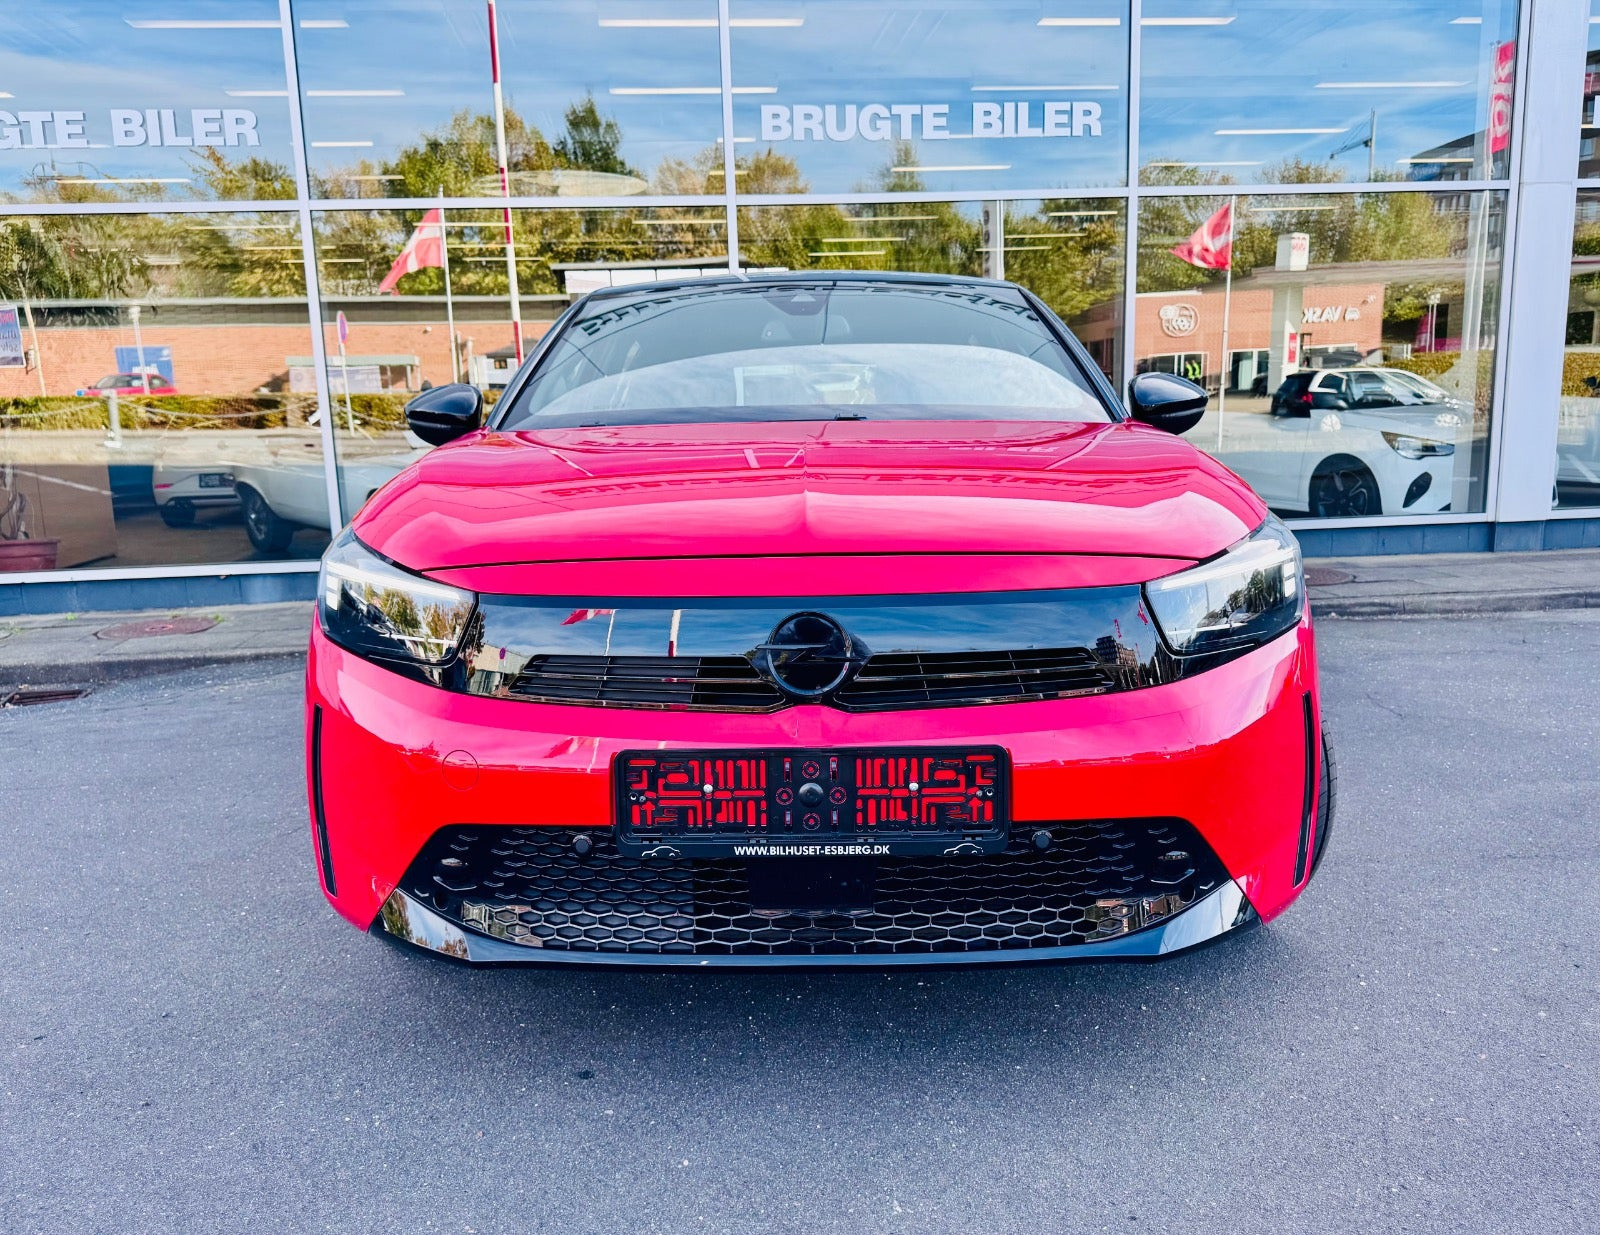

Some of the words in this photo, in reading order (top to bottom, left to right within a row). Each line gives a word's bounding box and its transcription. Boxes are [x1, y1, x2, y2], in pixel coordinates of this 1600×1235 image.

[110, 109, 260, 148] BILER
[760, 104, 949, 141] BRUGTE
[972, 102, 1101, 137] BILER
[734, 845, 890, 856] WWW.BILHUSET-ESBJERG.DK
